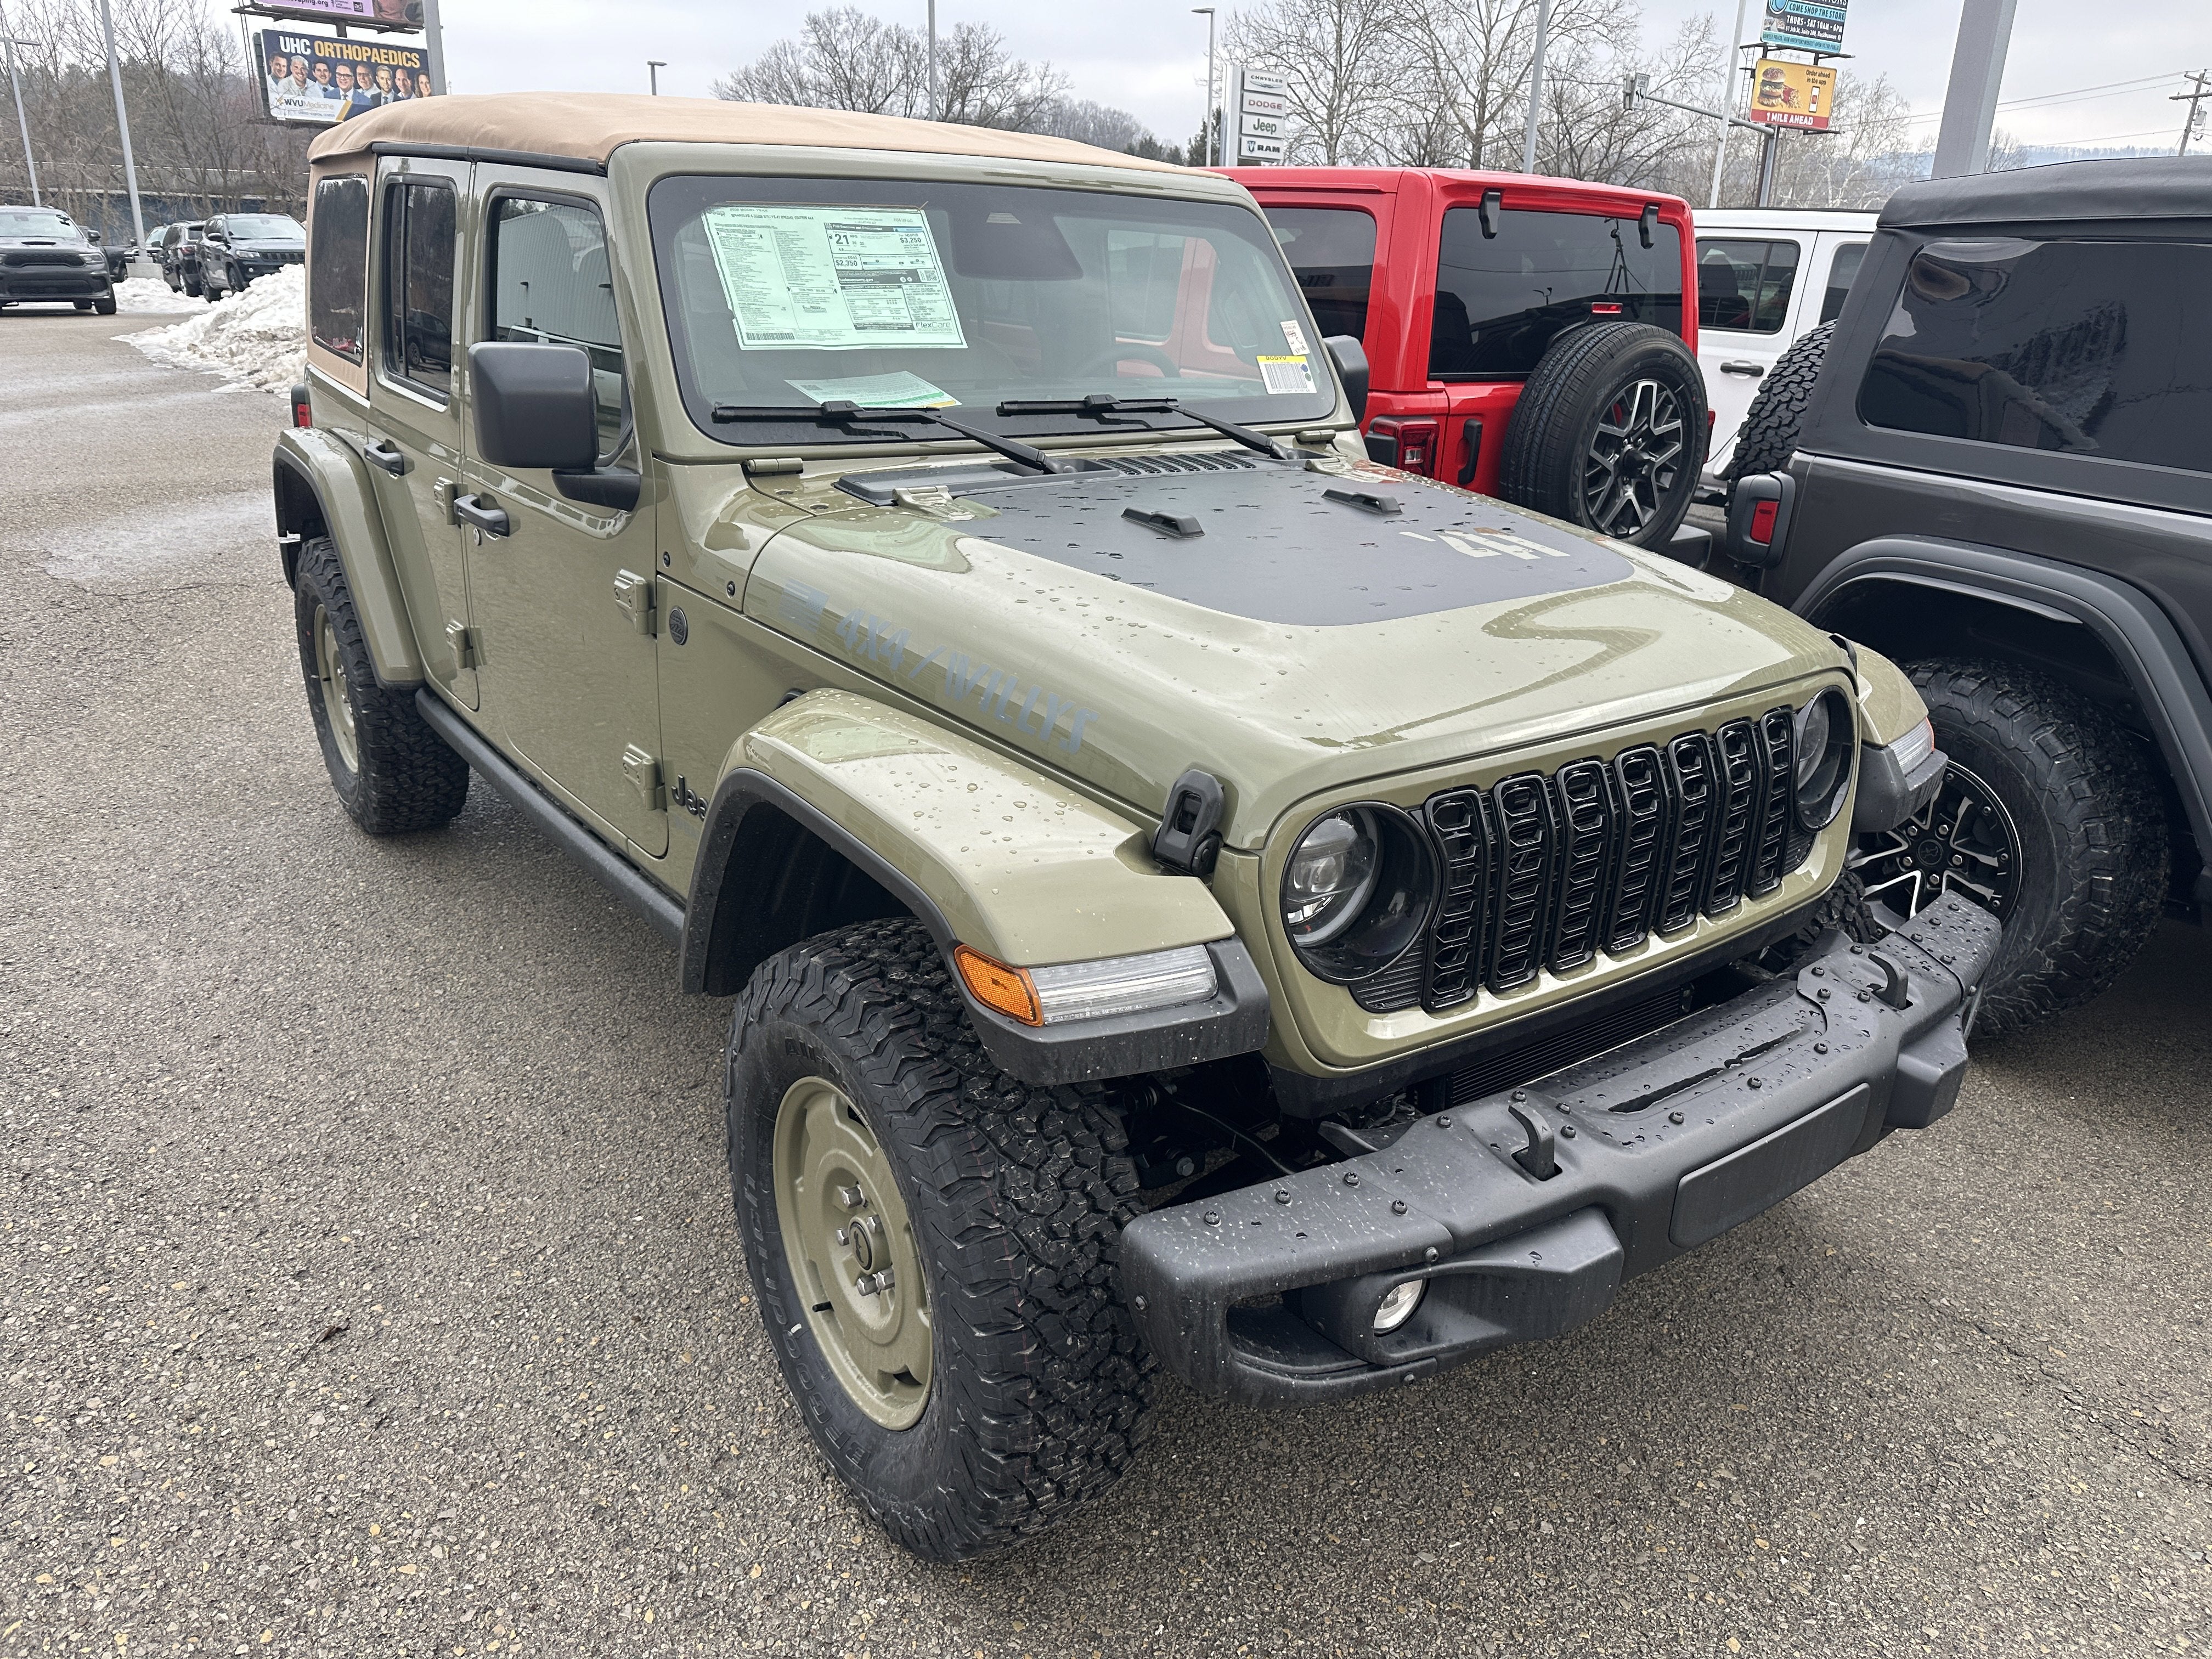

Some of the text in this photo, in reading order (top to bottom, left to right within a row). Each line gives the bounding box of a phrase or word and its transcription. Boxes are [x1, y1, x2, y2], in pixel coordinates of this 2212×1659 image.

[1789, 3, 1844, 20] COME SHOP THE STORE
[1787, 15, 1803, 26] THURS
[1807, 19, 1815, 27] SAT
[1818, 20, 1829, 30] 10AM
[1833, 24, 1843, 32] 6PM
[279, 36, 420, 68] UHC ORTHOPAEDICS
[1250, 75, 1283, 83] CHRYSLER
[1249, 99, 1283, 110] DODGE
[1253, 118, 1277, 134] Jeep
[1767, 112, 1814, 126] 1 MILE AHEAD
[1257, 144, 1280, 153] RAM
[834, 234, 849, 245] 21
